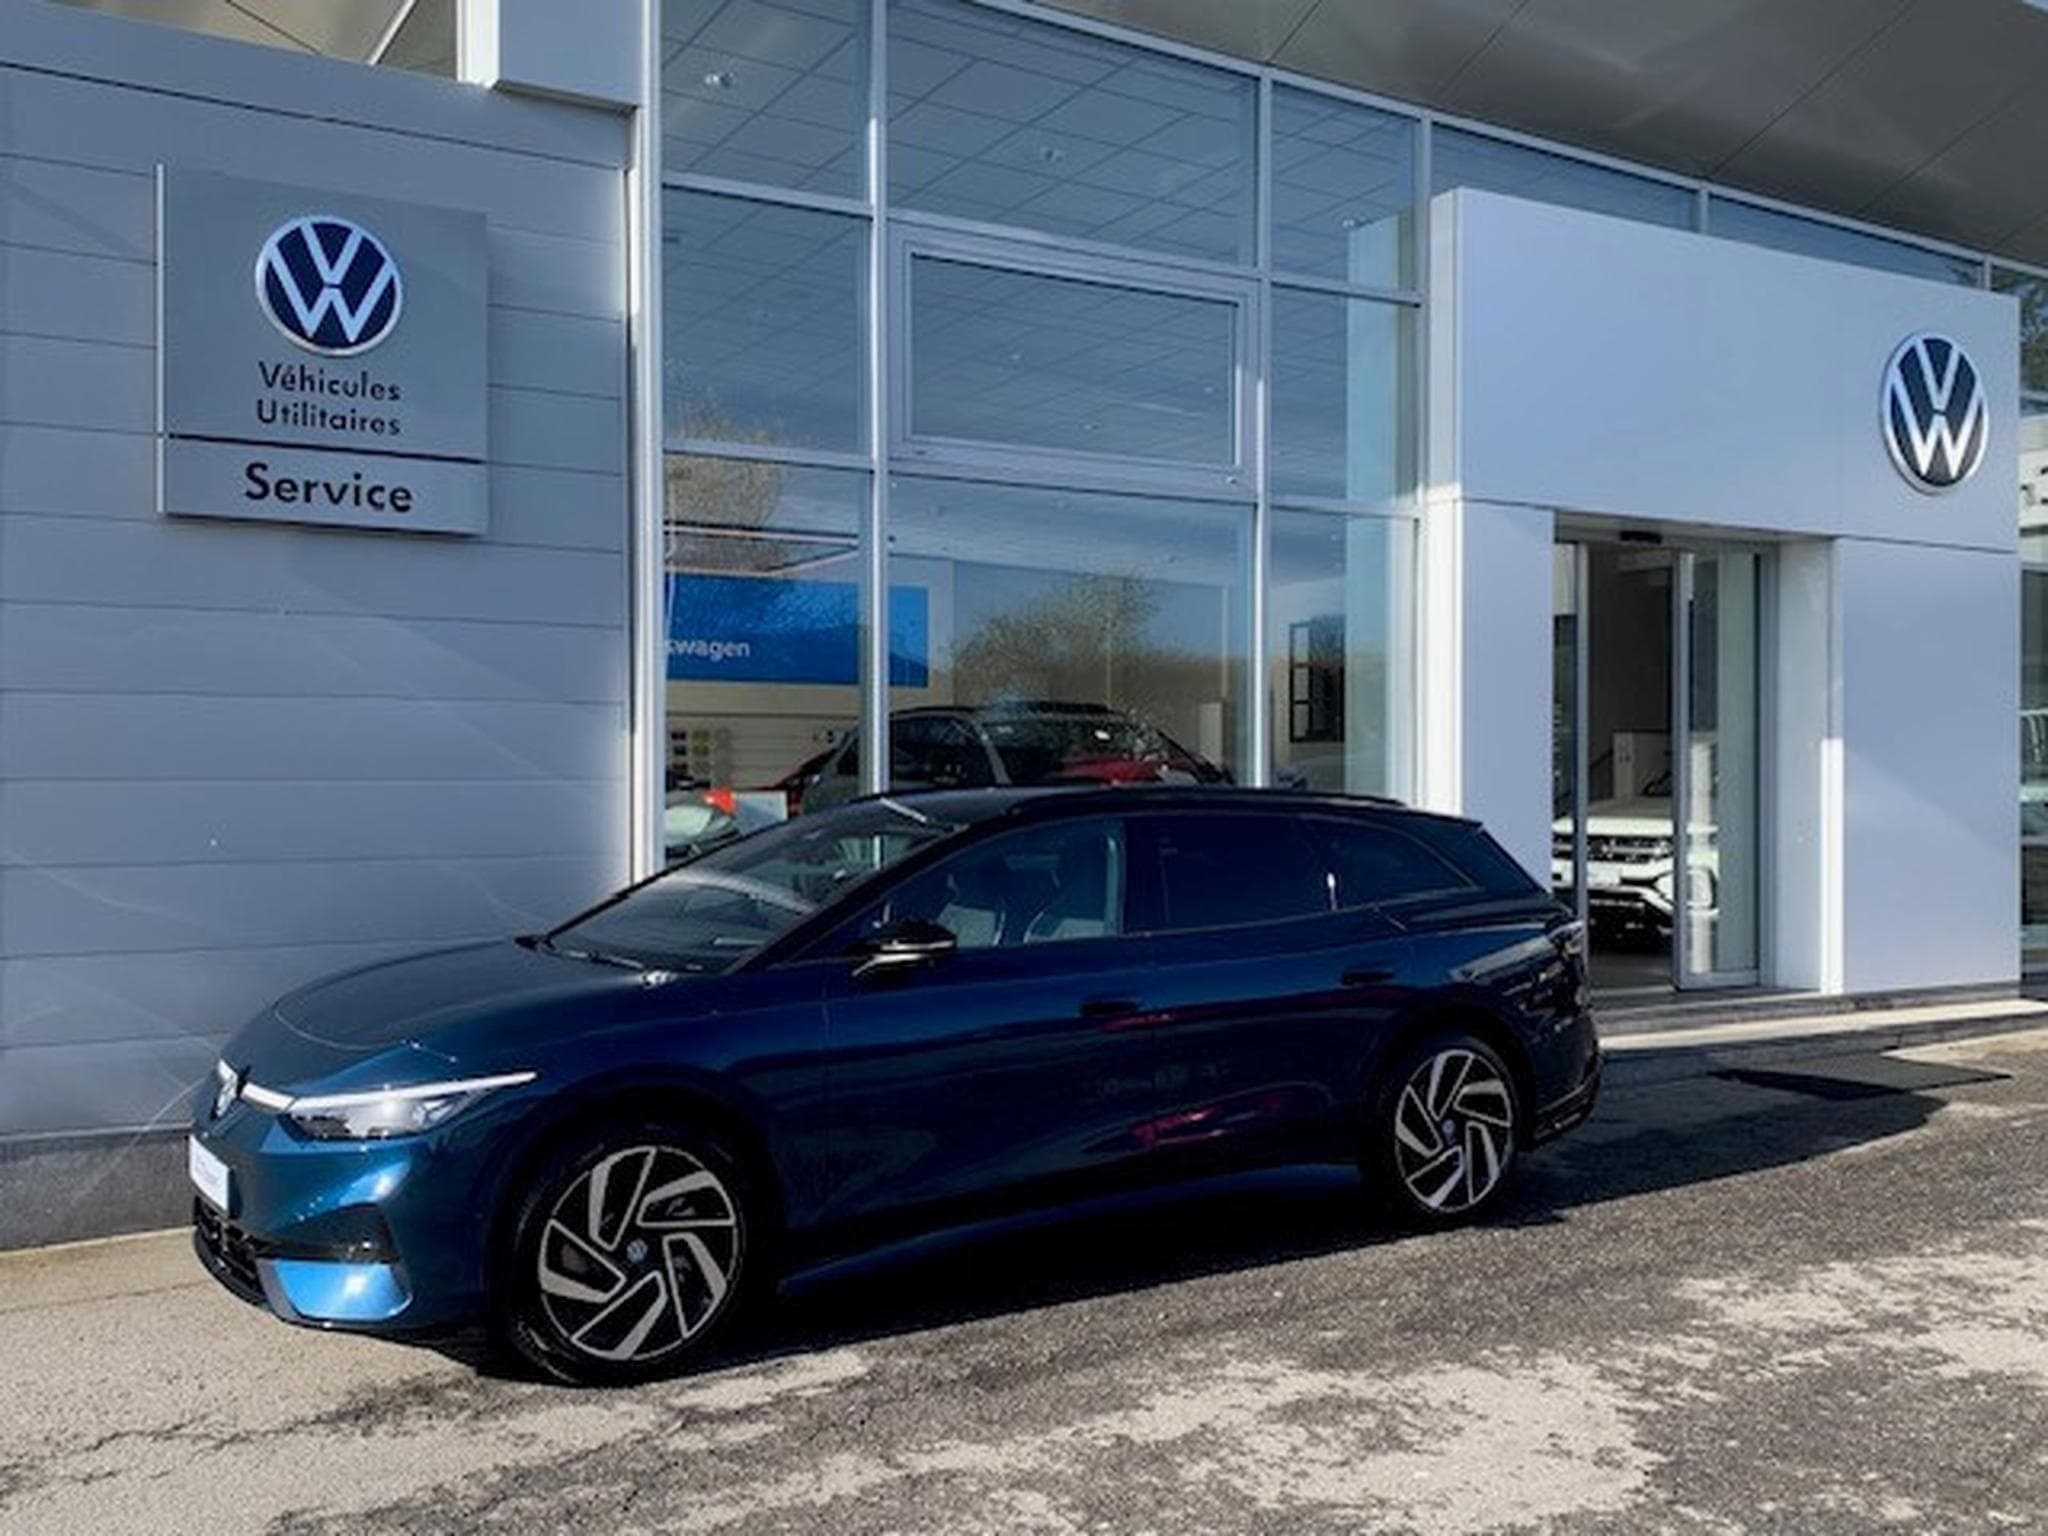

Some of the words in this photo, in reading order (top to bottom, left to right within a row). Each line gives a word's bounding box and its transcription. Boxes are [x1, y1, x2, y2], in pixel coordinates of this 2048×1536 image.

[257, 216, 401, 350] VW
[258, 361, 400, 400] Véhicules
[257, 399, 400, 435] Utilitaires
[1884, 334, 1986, 488] VW
[245, 462, 412, 512] Service
